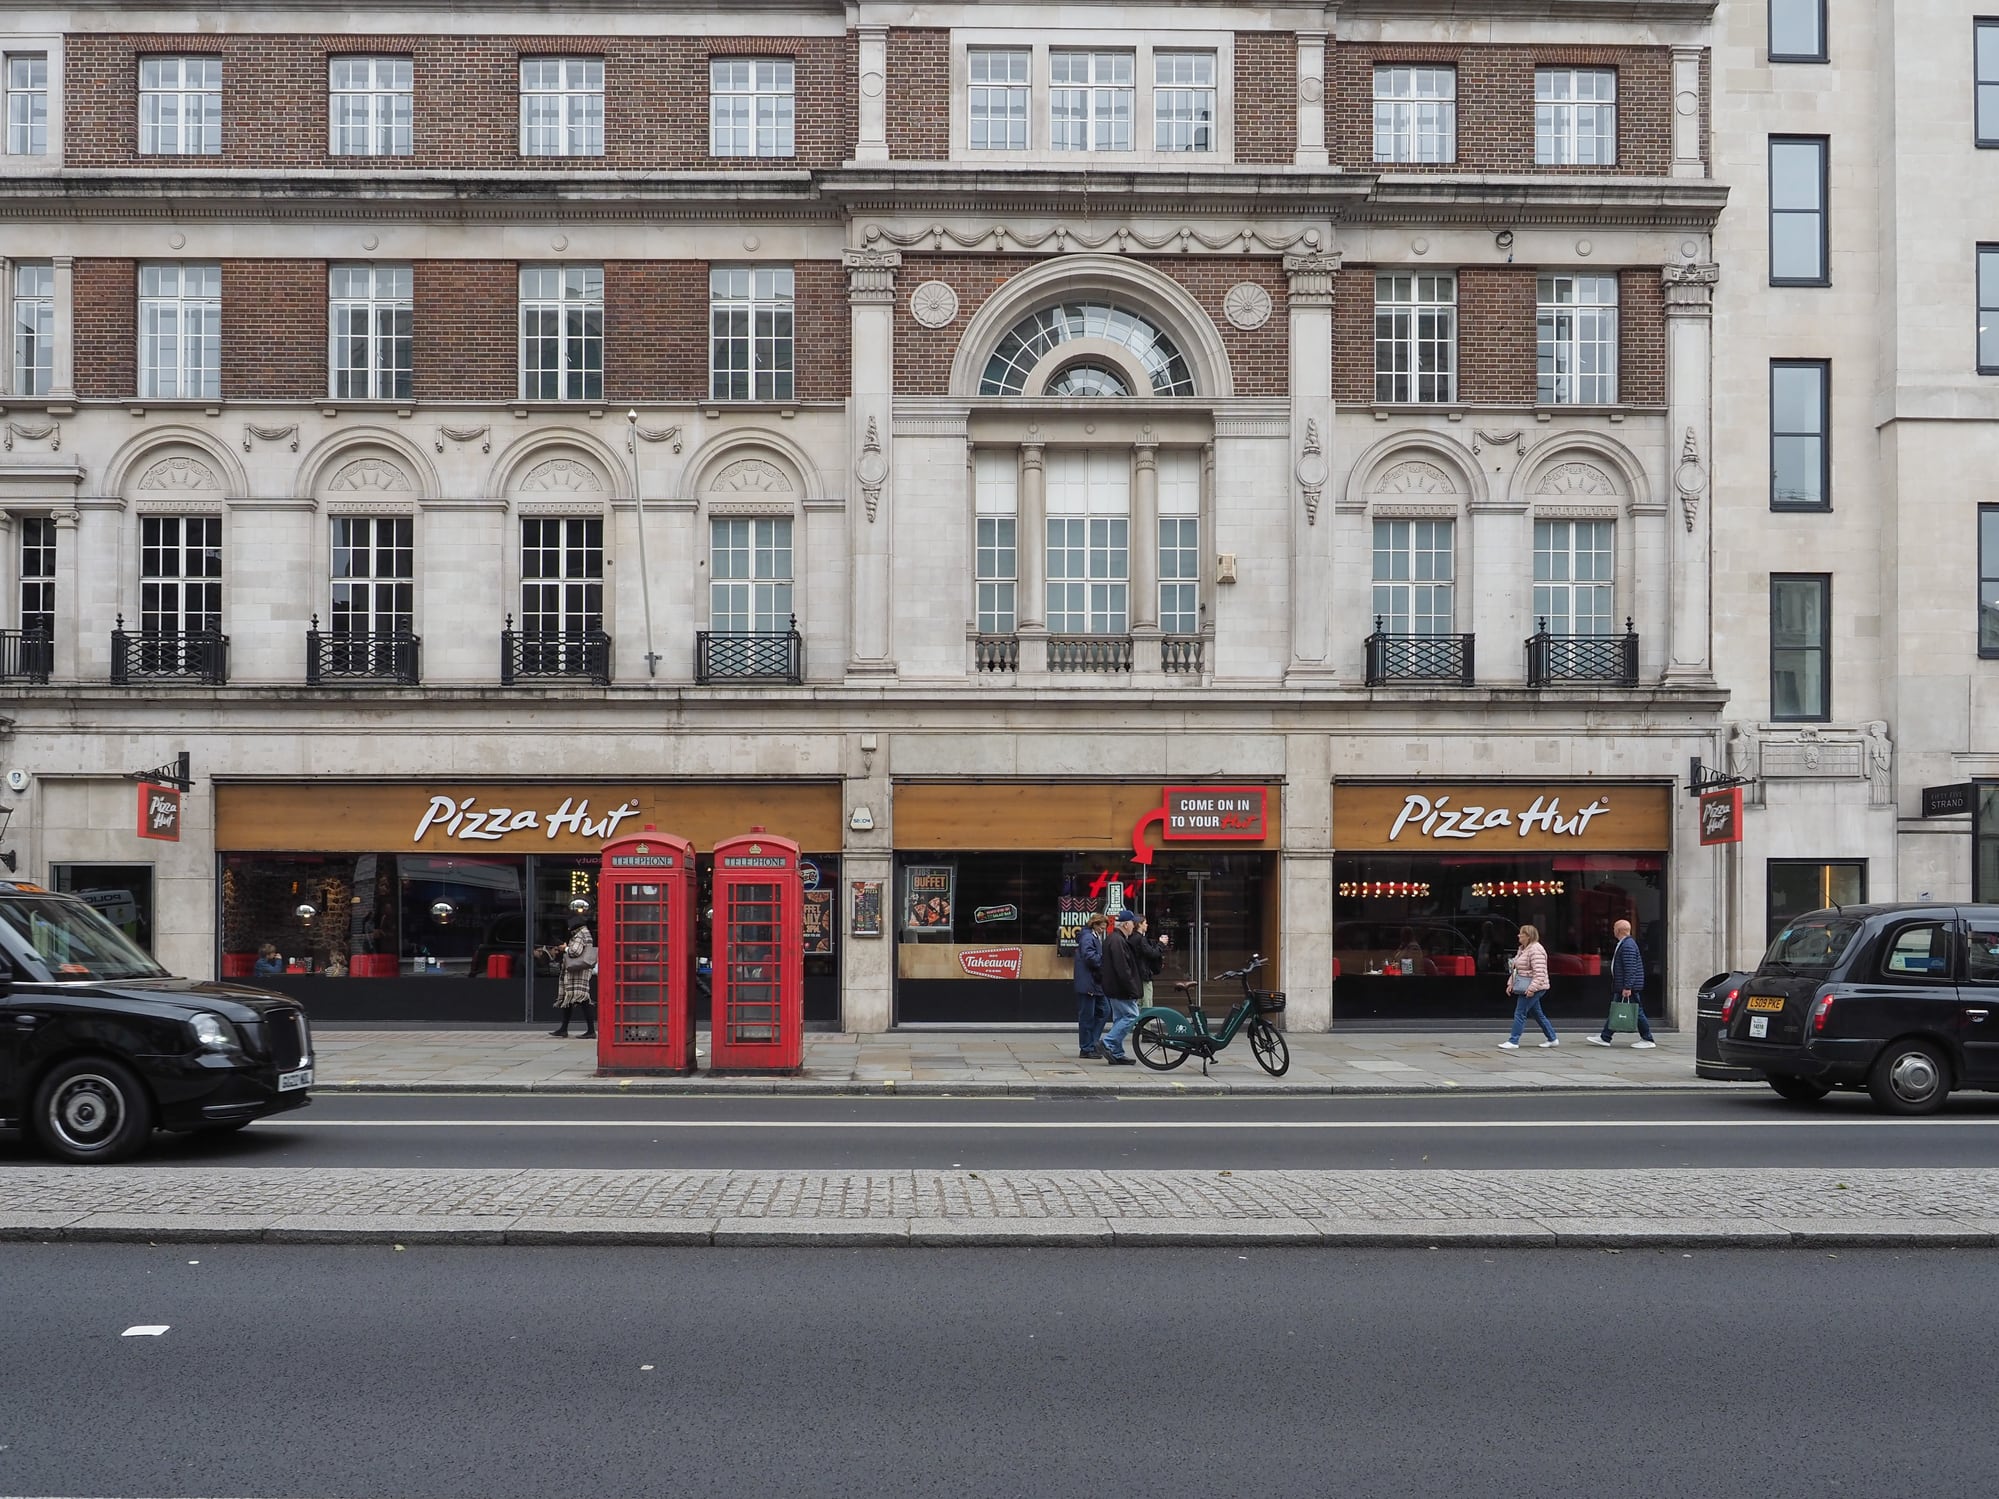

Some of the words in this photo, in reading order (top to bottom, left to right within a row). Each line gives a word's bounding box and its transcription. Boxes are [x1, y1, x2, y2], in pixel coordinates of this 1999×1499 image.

[149, 796, 177, 815] Pizza
[1180, 799, 1214, 811] COME
[1217, 799, 1233, 811] ON
[1237, 799, 1250, 811] IN
[1931, 798, 1964, 810] STRAND
[413, 795, 540, 842] Pizza
[545, 797, 641, 839] Hut
[1389, 794, 1512, 841] Pizza
[1517, 795, 1611, 836] Hut
[1702, 801, 1731, 823] Pizza
[153, 813, 176, 828] Hut
[1171, 816, 1185, 827] TO
[1189, 816, 1220, 827] YOUR
[1220, 811, 1259, 830] Hut
[1706, 815, 1729, 835] Hut
[615, 857, 673, 866] TELEPHONE
[727, 858, 786, 867] TELEPHONE
[914, 876, 946, 888] BUFFET
[1061, 926, 1082, 939] NO
[965, 956, 1017, 971] Takeaway
[1767, 998, 1782, 1009] PKE
